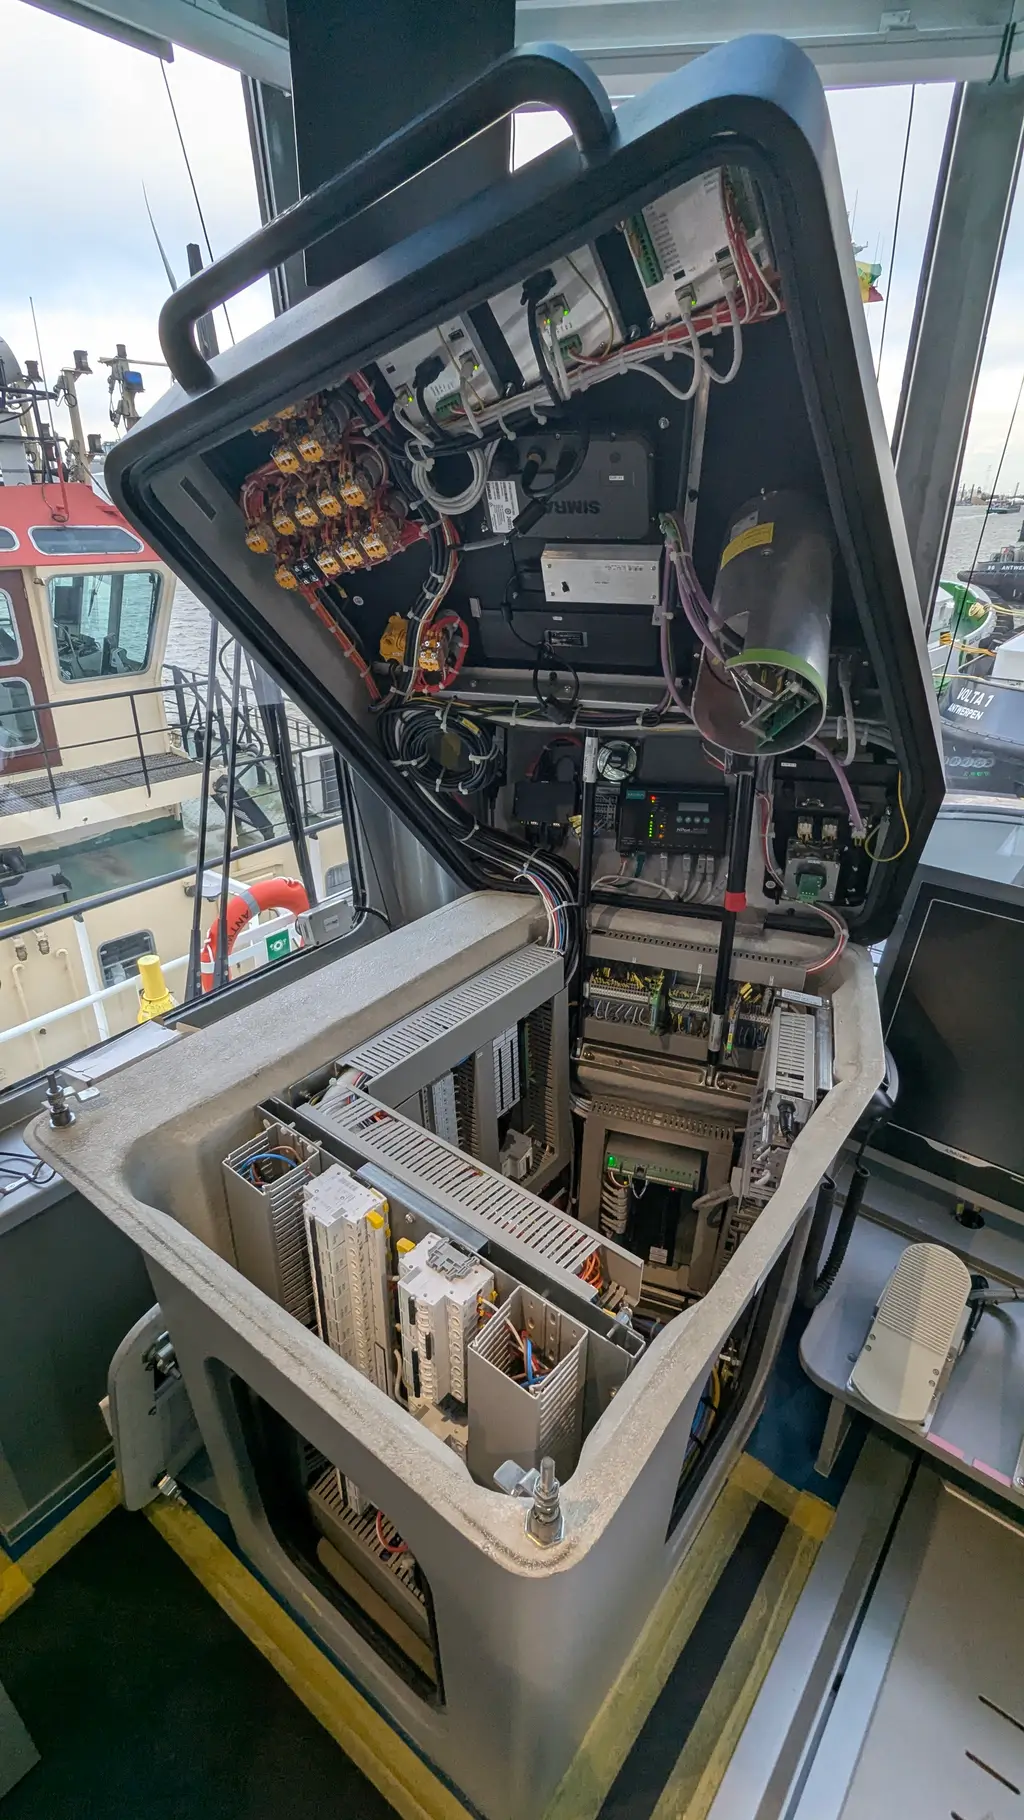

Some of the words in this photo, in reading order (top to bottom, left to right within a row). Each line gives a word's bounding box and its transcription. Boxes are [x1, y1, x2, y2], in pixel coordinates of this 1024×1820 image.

[546, 500, 601, 515] SIMRA
[956, 687, 985, 706] VOLTA
[984, 694, 995, 708] 1
[947, 702, 985, 721] ANTWERPEN
